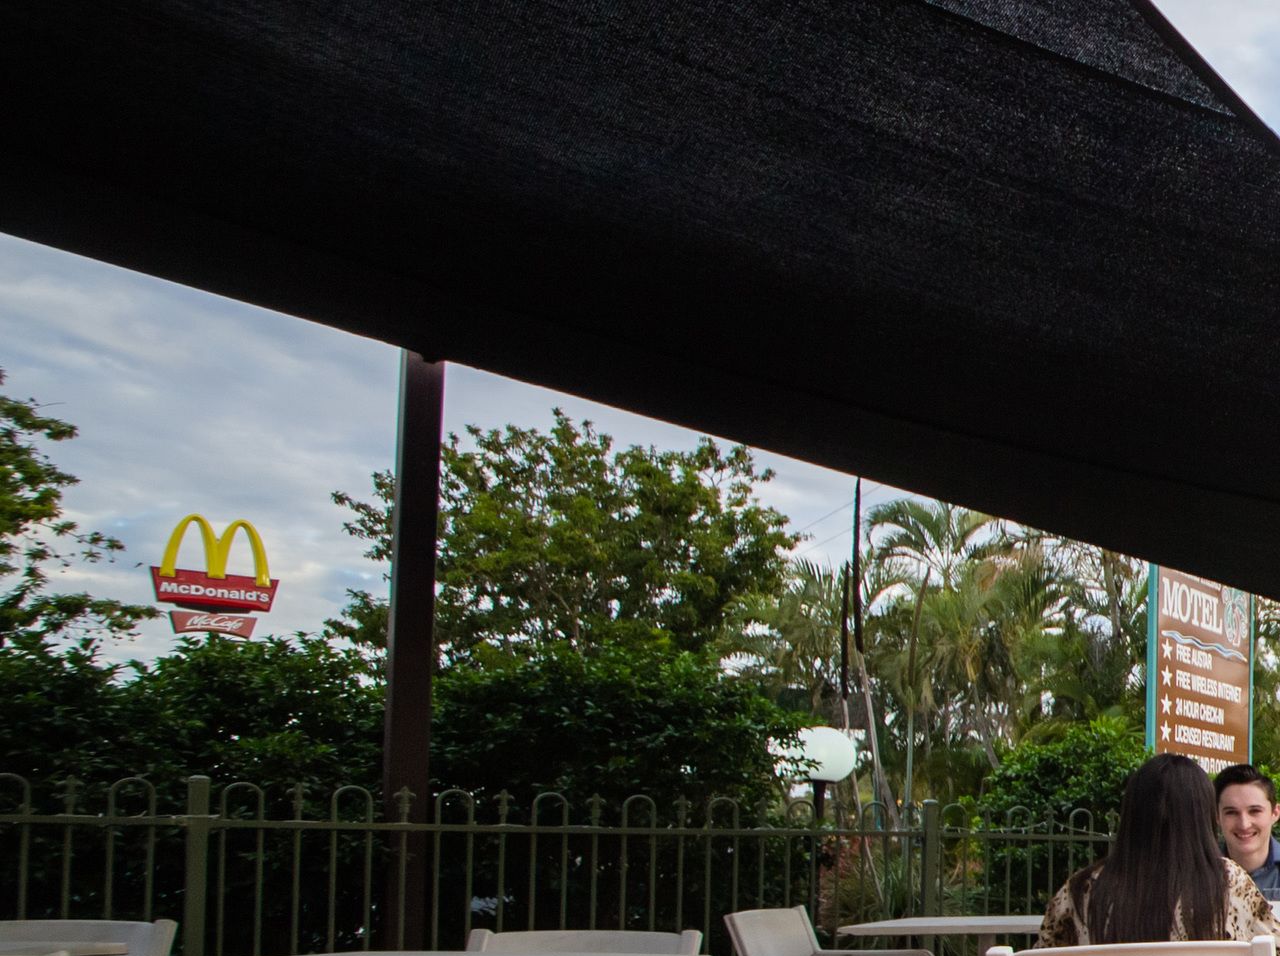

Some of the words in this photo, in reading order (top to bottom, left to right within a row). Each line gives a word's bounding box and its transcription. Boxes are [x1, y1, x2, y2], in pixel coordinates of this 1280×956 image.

[159, 581, 270, 603] McDonald's
[1162, 576, 1222, 635] MOTEL
[1176, 643, 1191, 665] FREE
[1191, 648, 1213, 671] AUSTAR
[1175, 669, 1191, 691] FREE
[1191, 674, 1217, 698] WIRELESS
[1217, 681, 1242, 704] INTERNET
[1175, 697, 1183, 716] 24
[1183, 699, 1200, 720] HOUR
[1174, 723, 1202, 747] LICENSED
[1201, 729, 1235, 753] RESTAURANT
